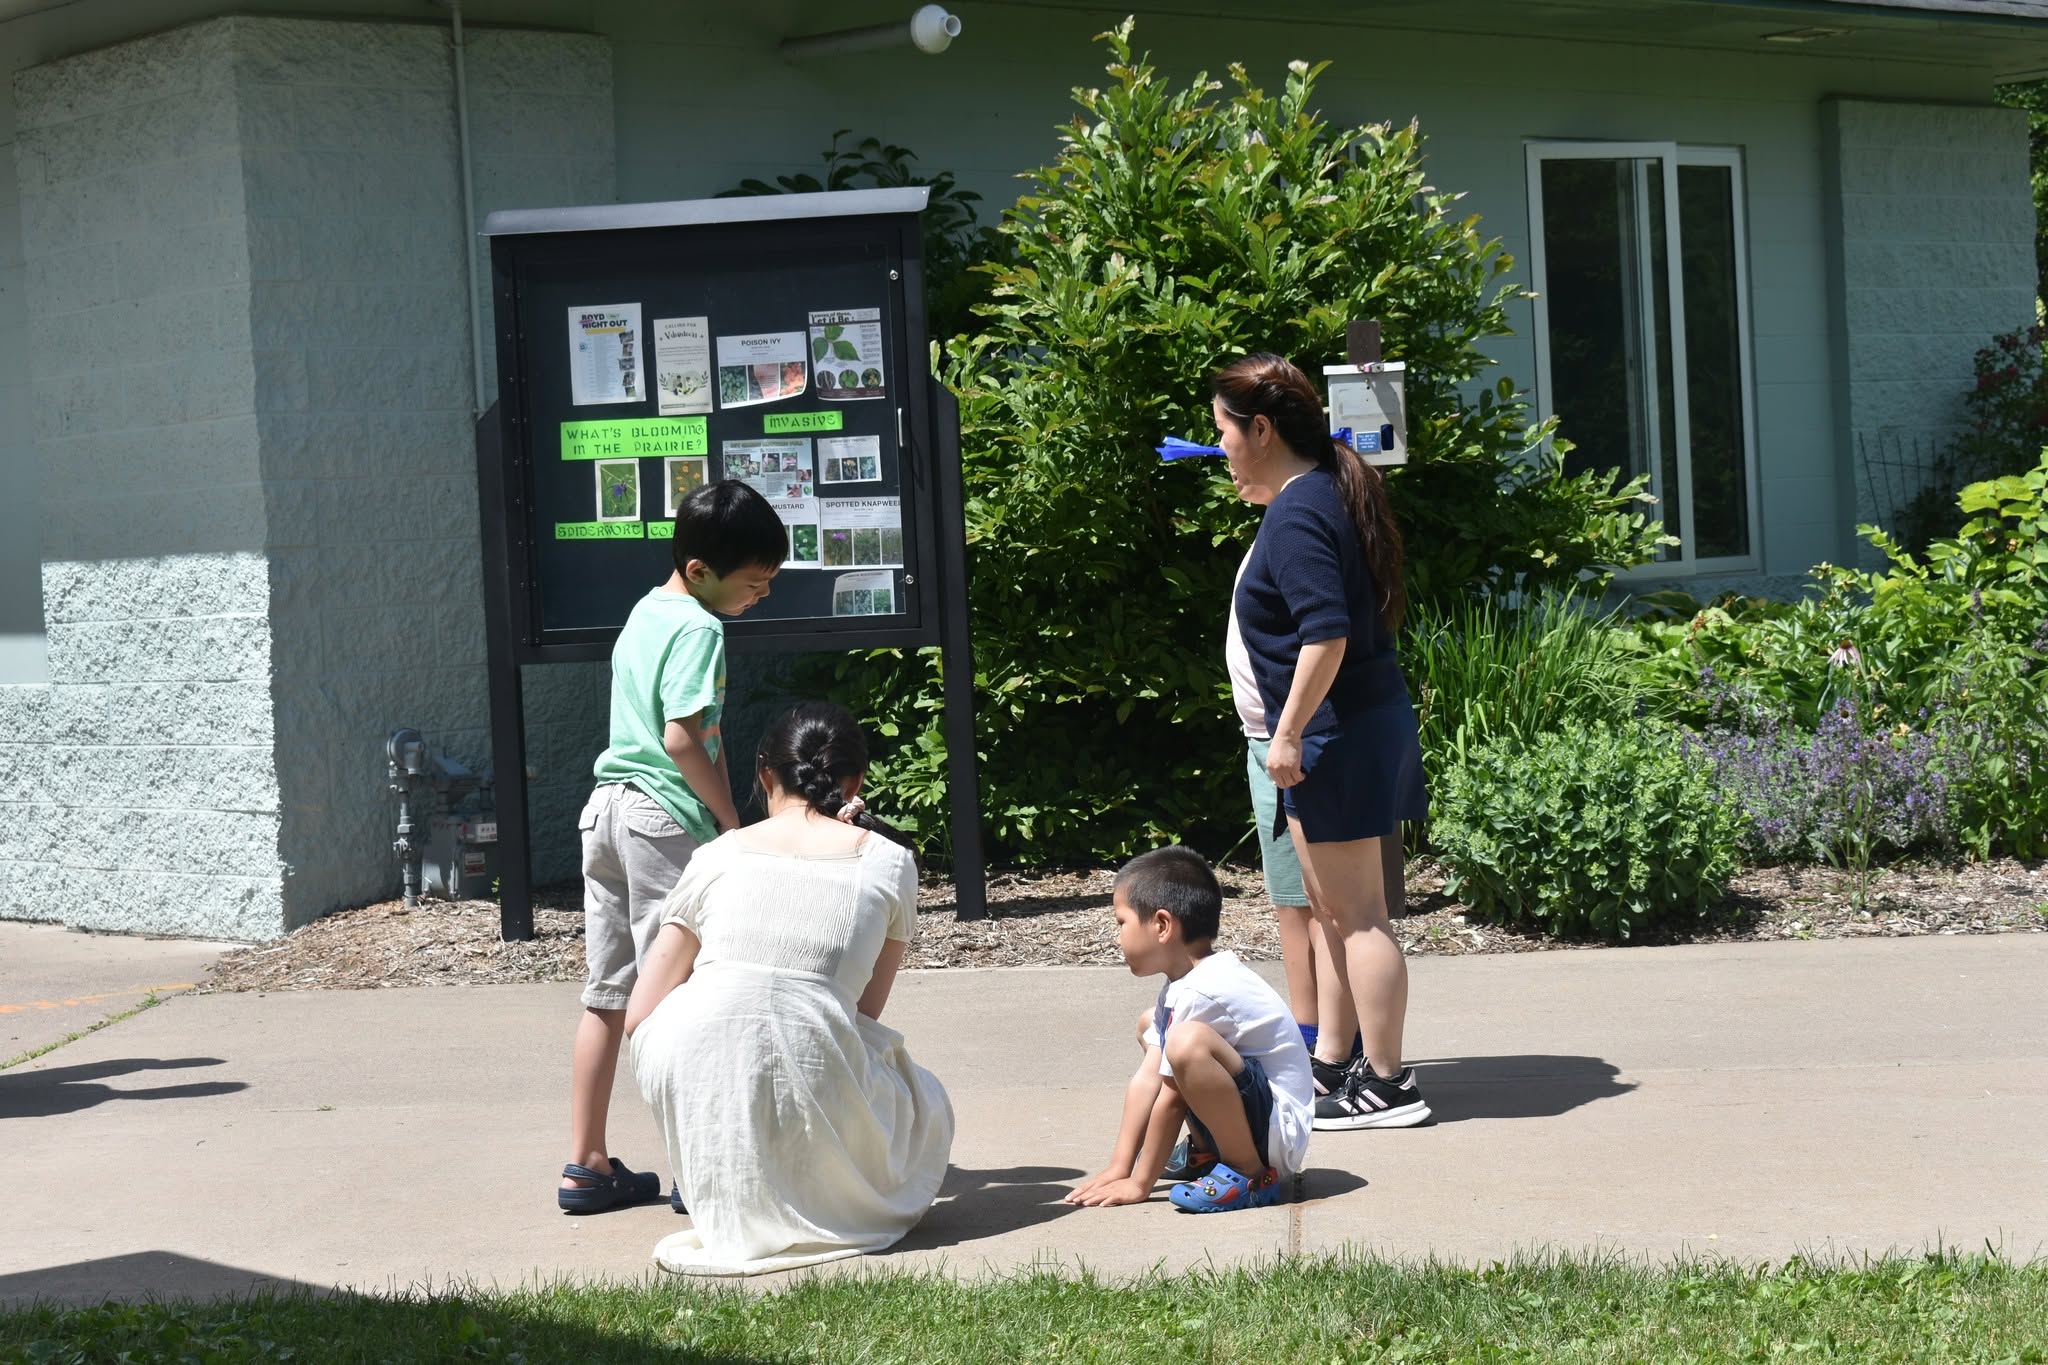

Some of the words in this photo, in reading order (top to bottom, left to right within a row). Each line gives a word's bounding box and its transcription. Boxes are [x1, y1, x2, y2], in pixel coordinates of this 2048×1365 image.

[582, 320, 608, 329] NIGHT
[609, 319, 628, 327] OUT
[741, 338, 768, 346] POISON
[566, 427, 622, 440] WHAT'S
[631, 424, 705, 438] BLOOMING
[594, 443, 622, 455] THE
[634, 439, 702, 452] PRAIRIE?
[557, 523, 641, 537] SPIDERWORT
